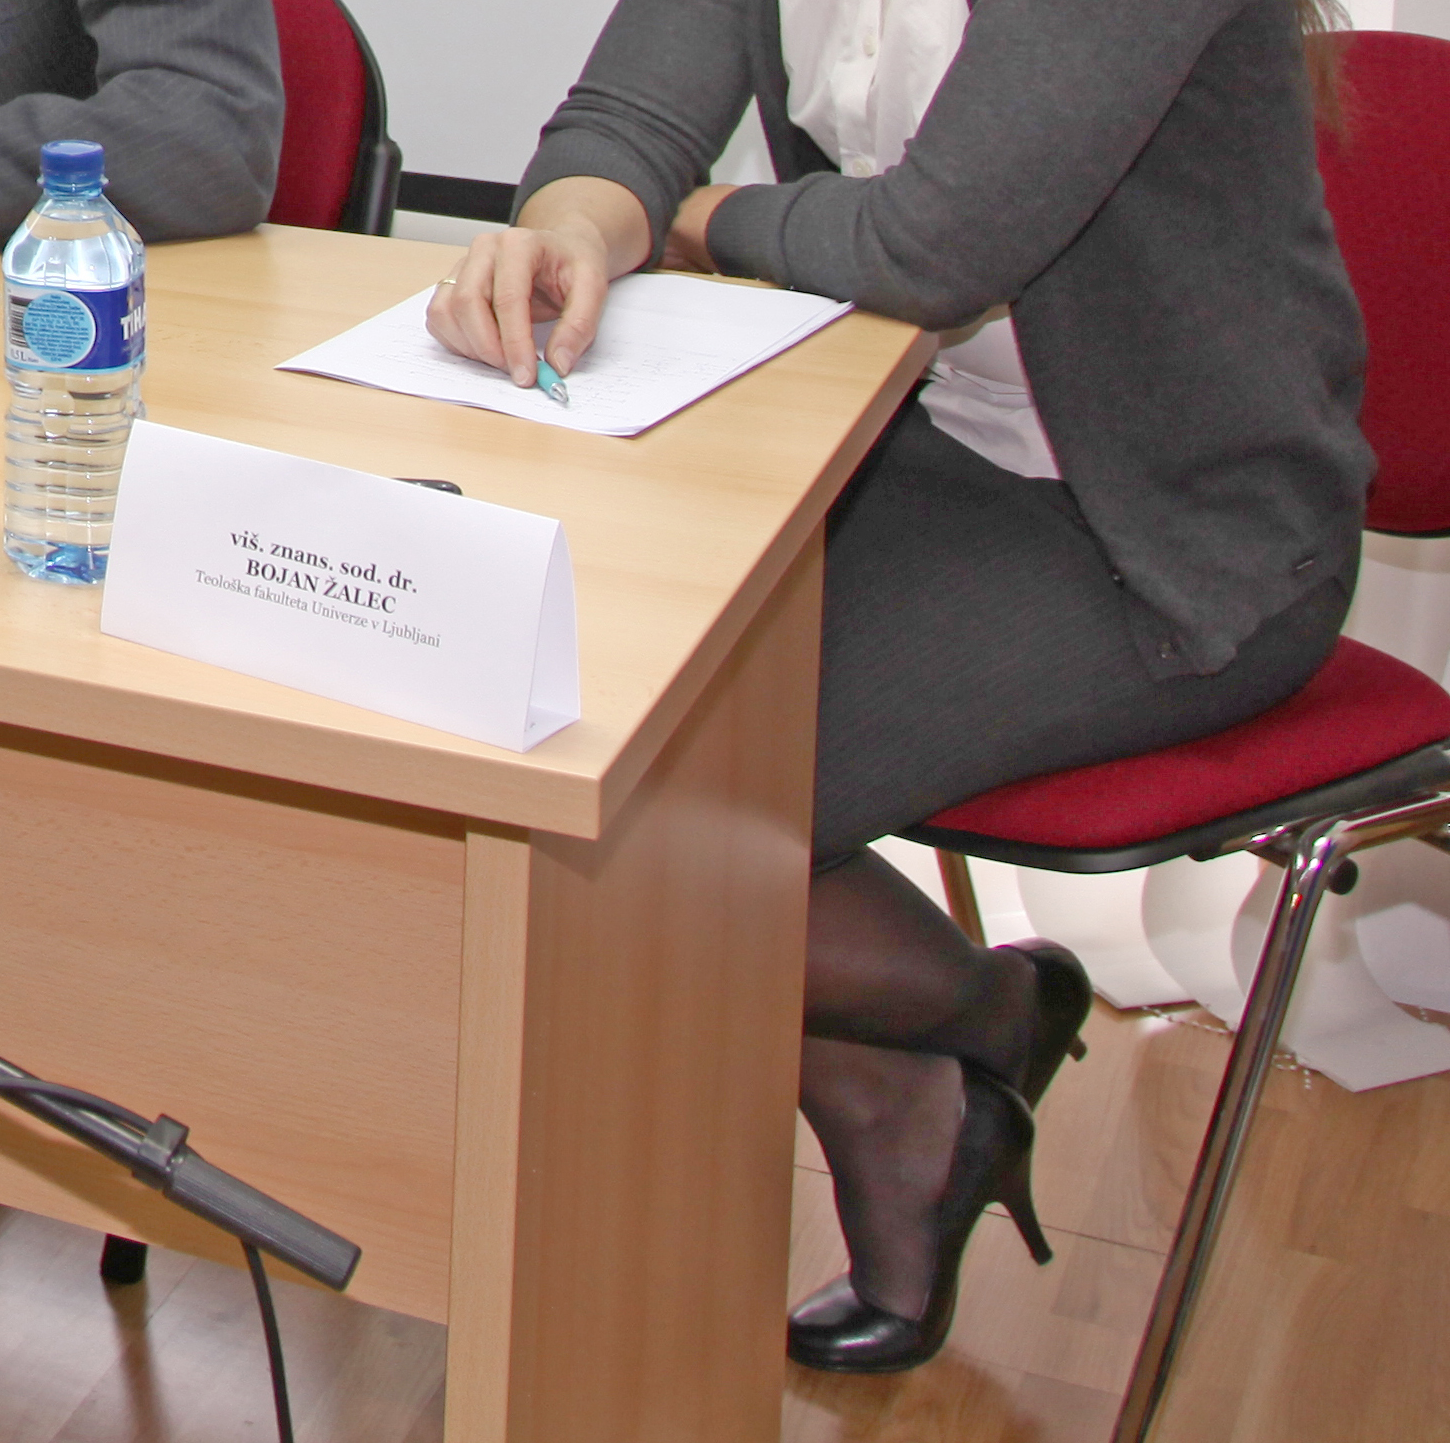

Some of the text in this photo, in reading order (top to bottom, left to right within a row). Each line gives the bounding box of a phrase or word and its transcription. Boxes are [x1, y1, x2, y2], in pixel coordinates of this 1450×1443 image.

[230, 530, 418, 593] viš. znans. sod. dr.
[246, 558, 397, 614] BOJAN ŽALEC
[196, 569, 441, 648] Teološka fakulteta Univerze v Ljubljani
